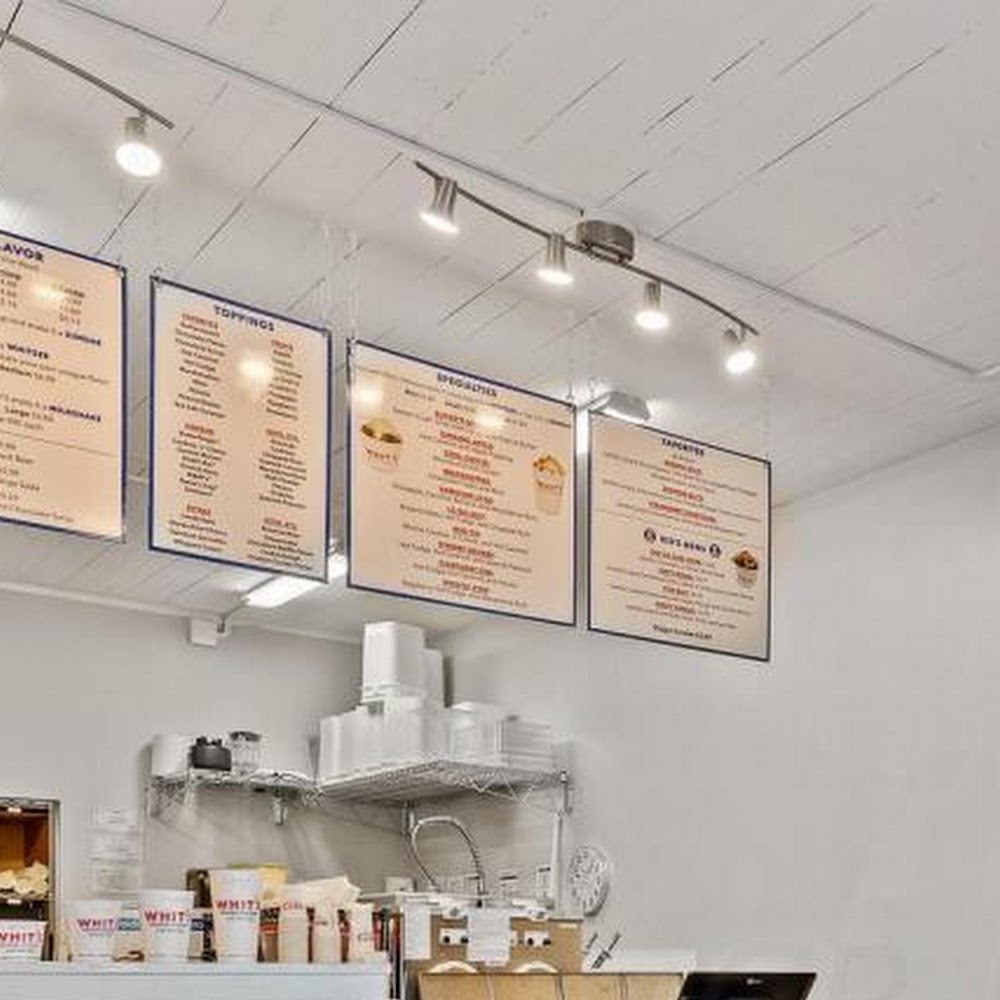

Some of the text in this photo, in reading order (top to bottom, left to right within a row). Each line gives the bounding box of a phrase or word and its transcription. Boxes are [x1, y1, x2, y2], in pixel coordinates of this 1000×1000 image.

[0, 243, 44, 263] AVOR
[213, 306, 275, 332] TOPPINGS
[437, 373, 497, 397] SPECIALTIES
